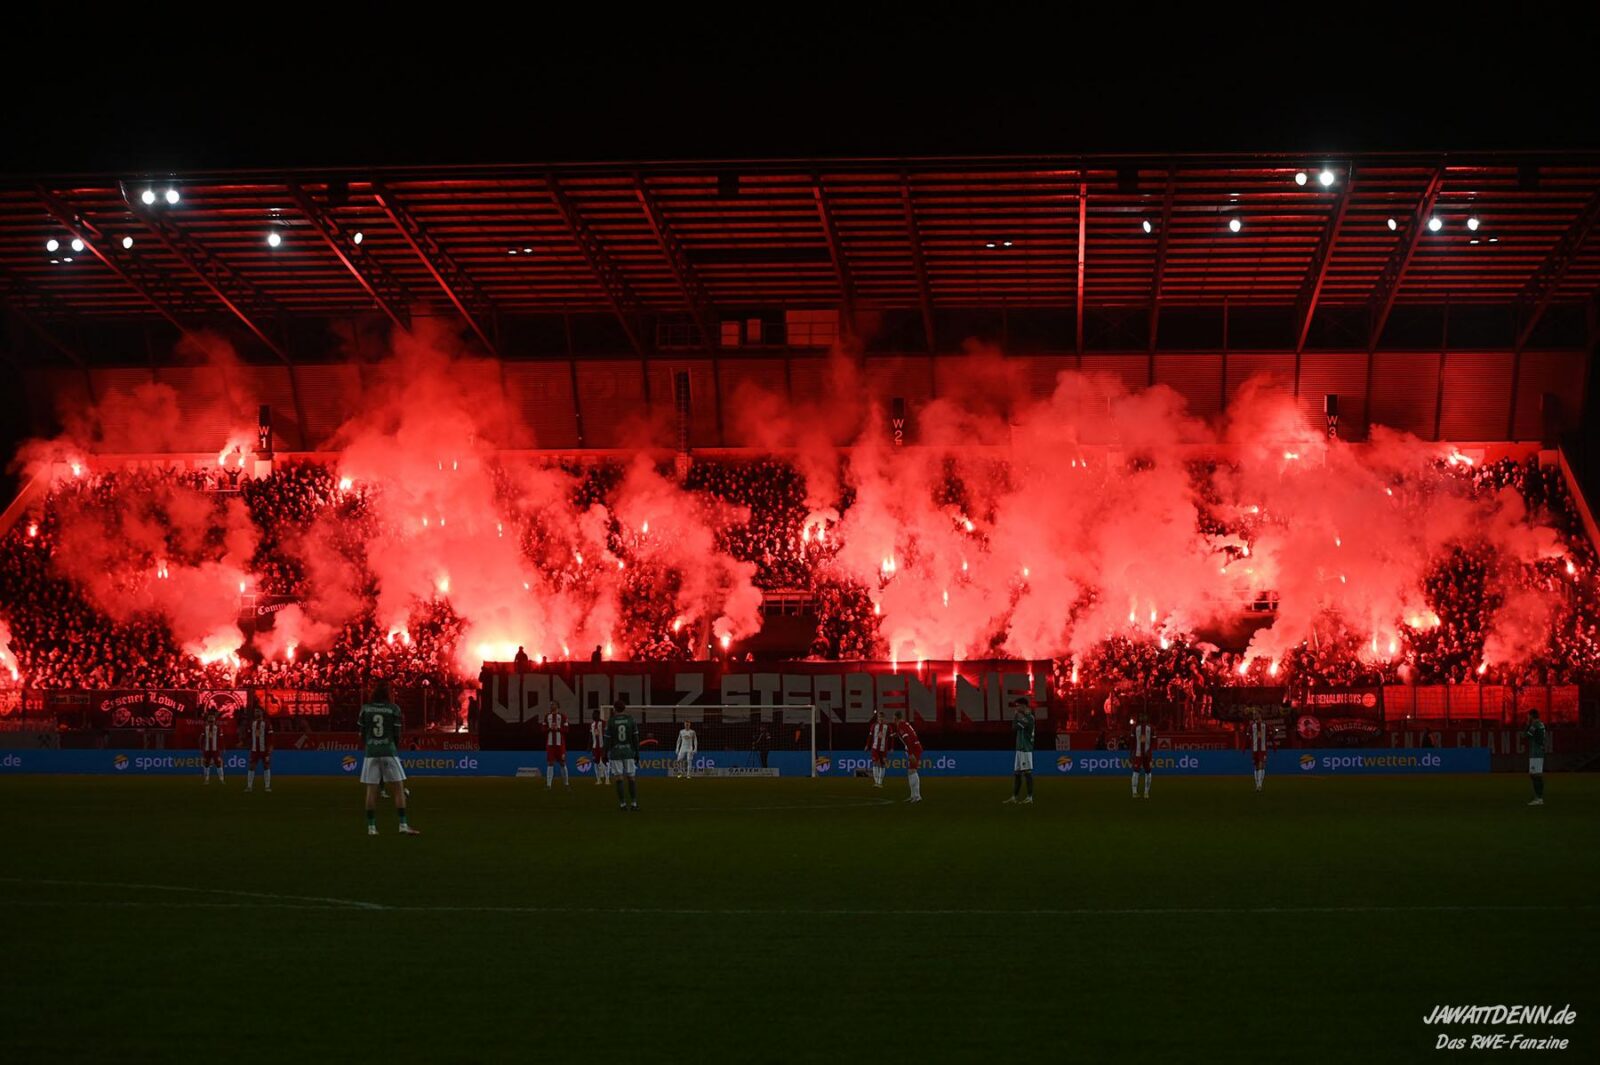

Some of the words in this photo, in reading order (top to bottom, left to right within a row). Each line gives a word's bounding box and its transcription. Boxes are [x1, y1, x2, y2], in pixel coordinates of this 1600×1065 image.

[720, 672, 937, 724] STERBEN
[955, 671, 1048, 723] NIE!
[372, 714, 384, 737] 3
[617, 724, 626, 742] 8
[135, 755, 246, 770] sportwett.de
[1322, 754, 1441, 769] sportwetten.de
